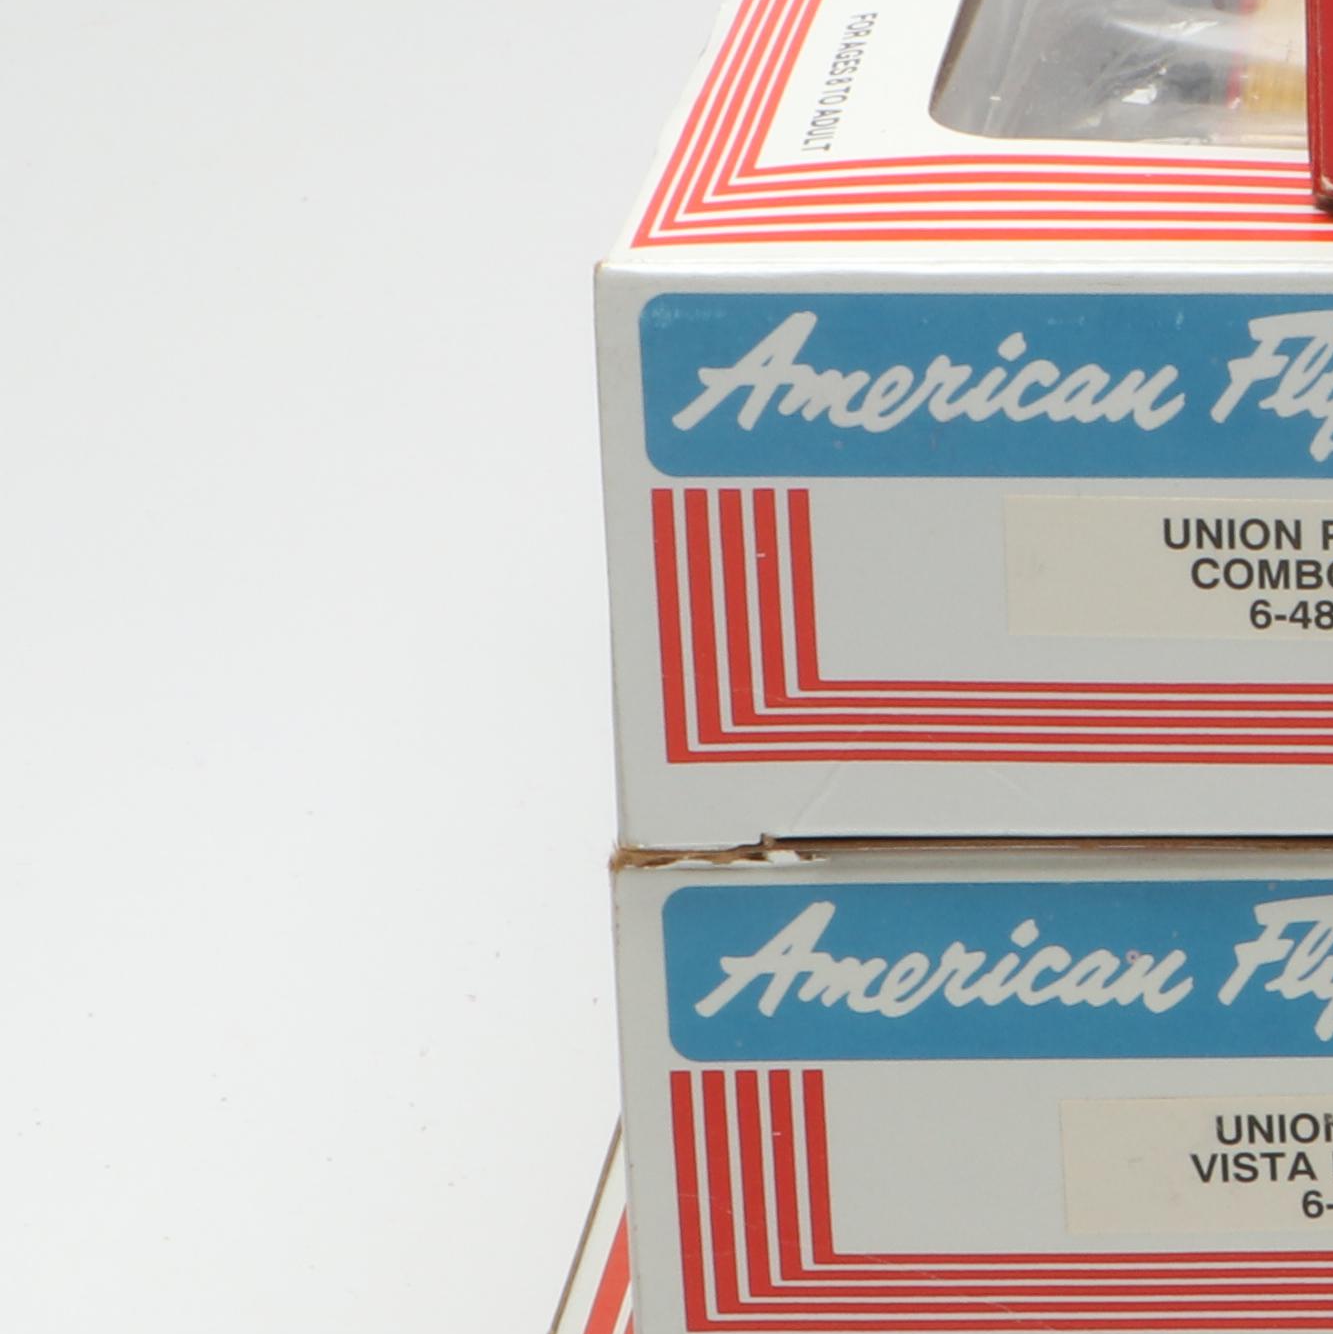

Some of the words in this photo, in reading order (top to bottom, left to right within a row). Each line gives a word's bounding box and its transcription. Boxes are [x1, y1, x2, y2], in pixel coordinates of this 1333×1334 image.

[841, 11, 879, 41] FOR
[828, 41, 867, 76] AGES
[817, 85, 851, 106] TO
[825, 76, 854, 87] 8
[801, 108, 843, 152] ADULT
[671, 310, 1187, 434] American
[1164, 519, 1303, 552] UNION
[694, 900, 1195, 1018] American
[1191, 1152, 1318, 1184] VISTA
